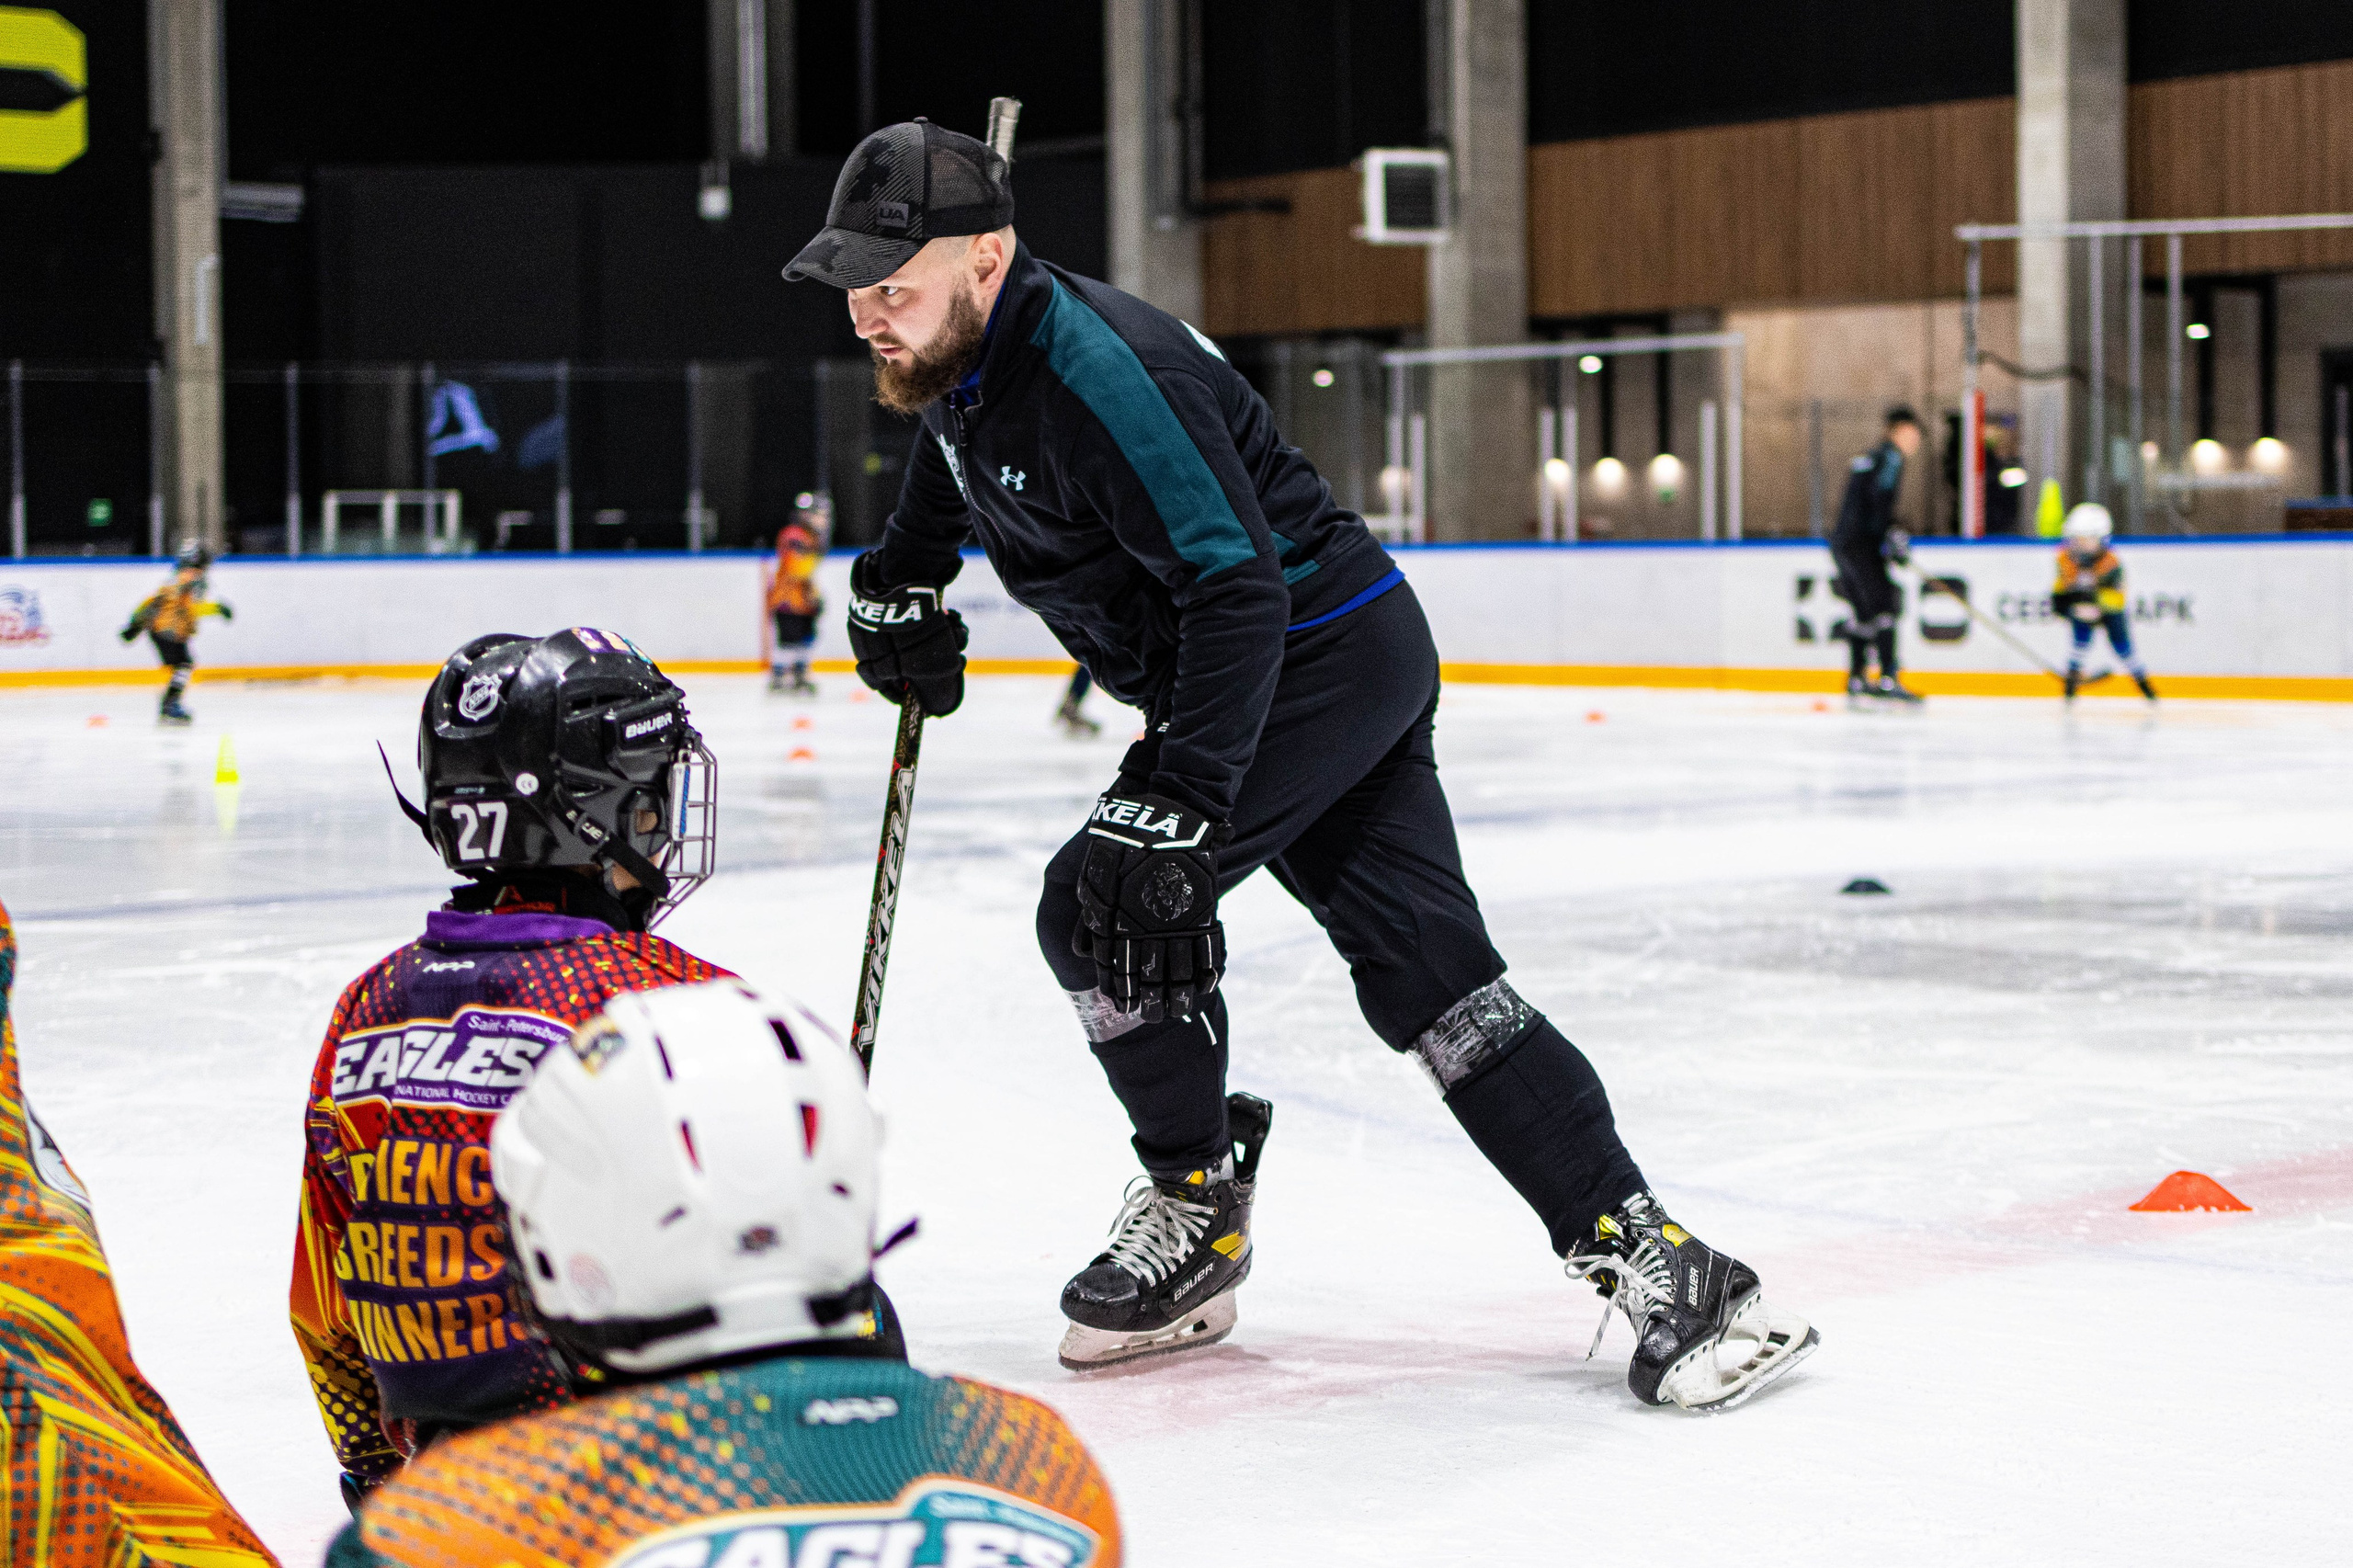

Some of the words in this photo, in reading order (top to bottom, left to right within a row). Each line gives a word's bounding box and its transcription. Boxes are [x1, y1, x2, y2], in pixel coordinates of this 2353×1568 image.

[879, 207, 905, 222] UA
[450, 801, 509, 860] 27
[332, 1030, 545, 1096] EAGLES
